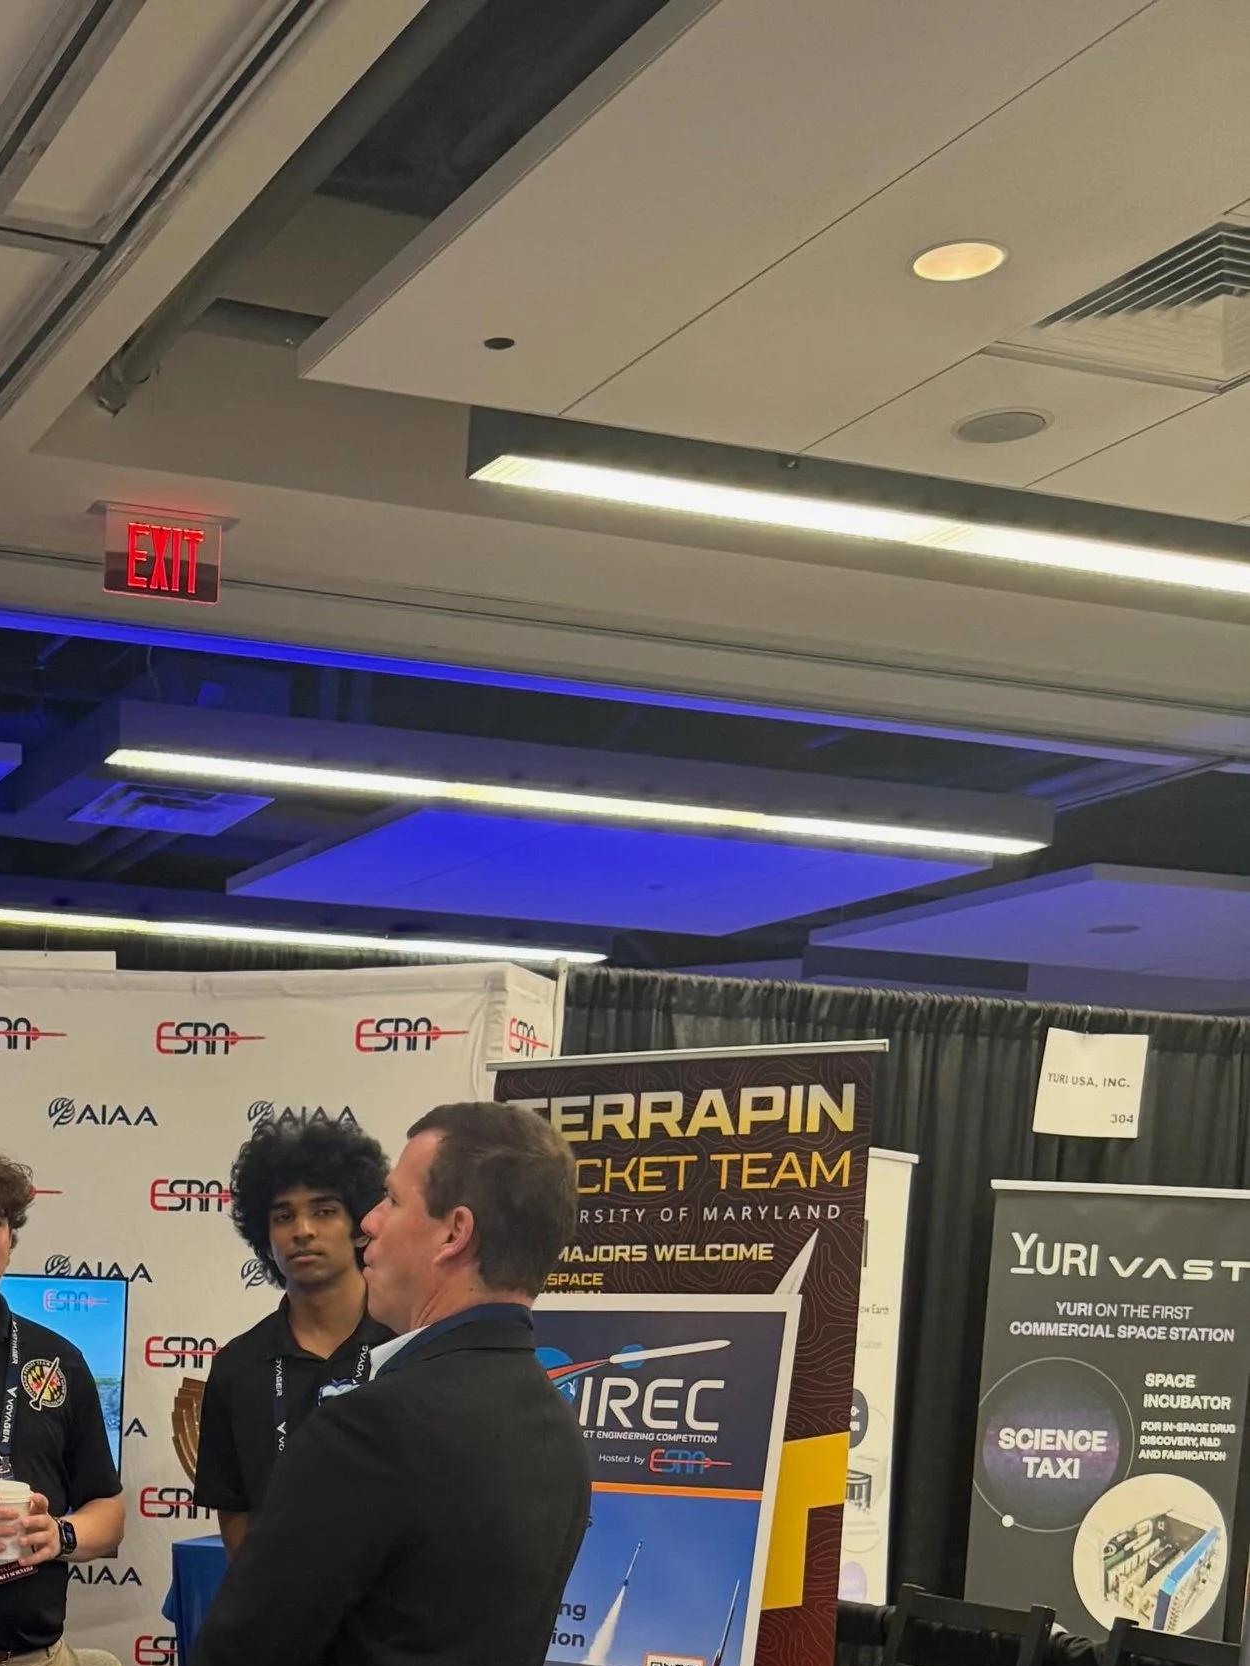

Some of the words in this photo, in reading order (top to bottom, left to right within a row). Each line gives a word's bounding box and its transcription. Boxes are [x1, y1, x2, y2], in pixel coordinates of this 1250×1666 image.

[127, 522, 204, 594] EXIT
[1048, 1072, 1068, 1083] YURI
[1071, 1076, 1098, 1088] USA,
[1103, 1078, 1130, 1088] INC.
[76, 1104, 158, 1126] AIAA
[1110, 1114, 1134, 1124] 304
[575, 1155, 697, 1194] CKET
[710, 1150, 851, 1191] TEAM
[580, 1208, 646, 1224] RSITY
[660, 1207, 689, 1221] OF
[703, 1204, 841, 1221] MARYLAND
[654, 1243, 774, 1262] WELCOME
[1010, 1232, 1099, 1276] YURI
[1108, 1255, 1250, 1282] VAST
[547, 1272, 603, 1286] SPACE
[1056, 1301, 1092, 1316] YURI
[1095, 1303, 1115, 1317] ON
[1120, 1304, 1149, 1318] THE
[1153, 1305, 1193, 1319] FIRST
[1009, 1321, 1115, 1338] COMMERCIAL
[1117, 1325, 1167, 1340] SPACE
[1169, 1326, 1235, 1342] STATION
[1144, 1373, 1196, 1388] SPACE
[579, 1376, 725, 1431] IREC
[1143, 1394, 1231, 1410] INCUBATOR
[1, 1400, 15, 1443] VOYAGER
[1141, 1421, 1161, 1431] FOR
[1163, 1422, 1209, 1432] IN-SPACE
[1210, 1424, 1236, 1434] DRUG
[597, 1431, 655, 1441] ENGINEERING
[657, 1433, 717, 1444] COMPETITION
[998, 1428, 1108, 1452] SCIENCE
[1140, 1435, 1199, 1448] DISCOVERY,
[599, 1454, 630, 1463] Hosted
[634, 1456, 645, 1466] by
[1138, 1449, 1161, 1459] AND
[1162, 1450, 1226, 1461] FABRICATION
[1023, 1457, 1080, 1479] TAXI
